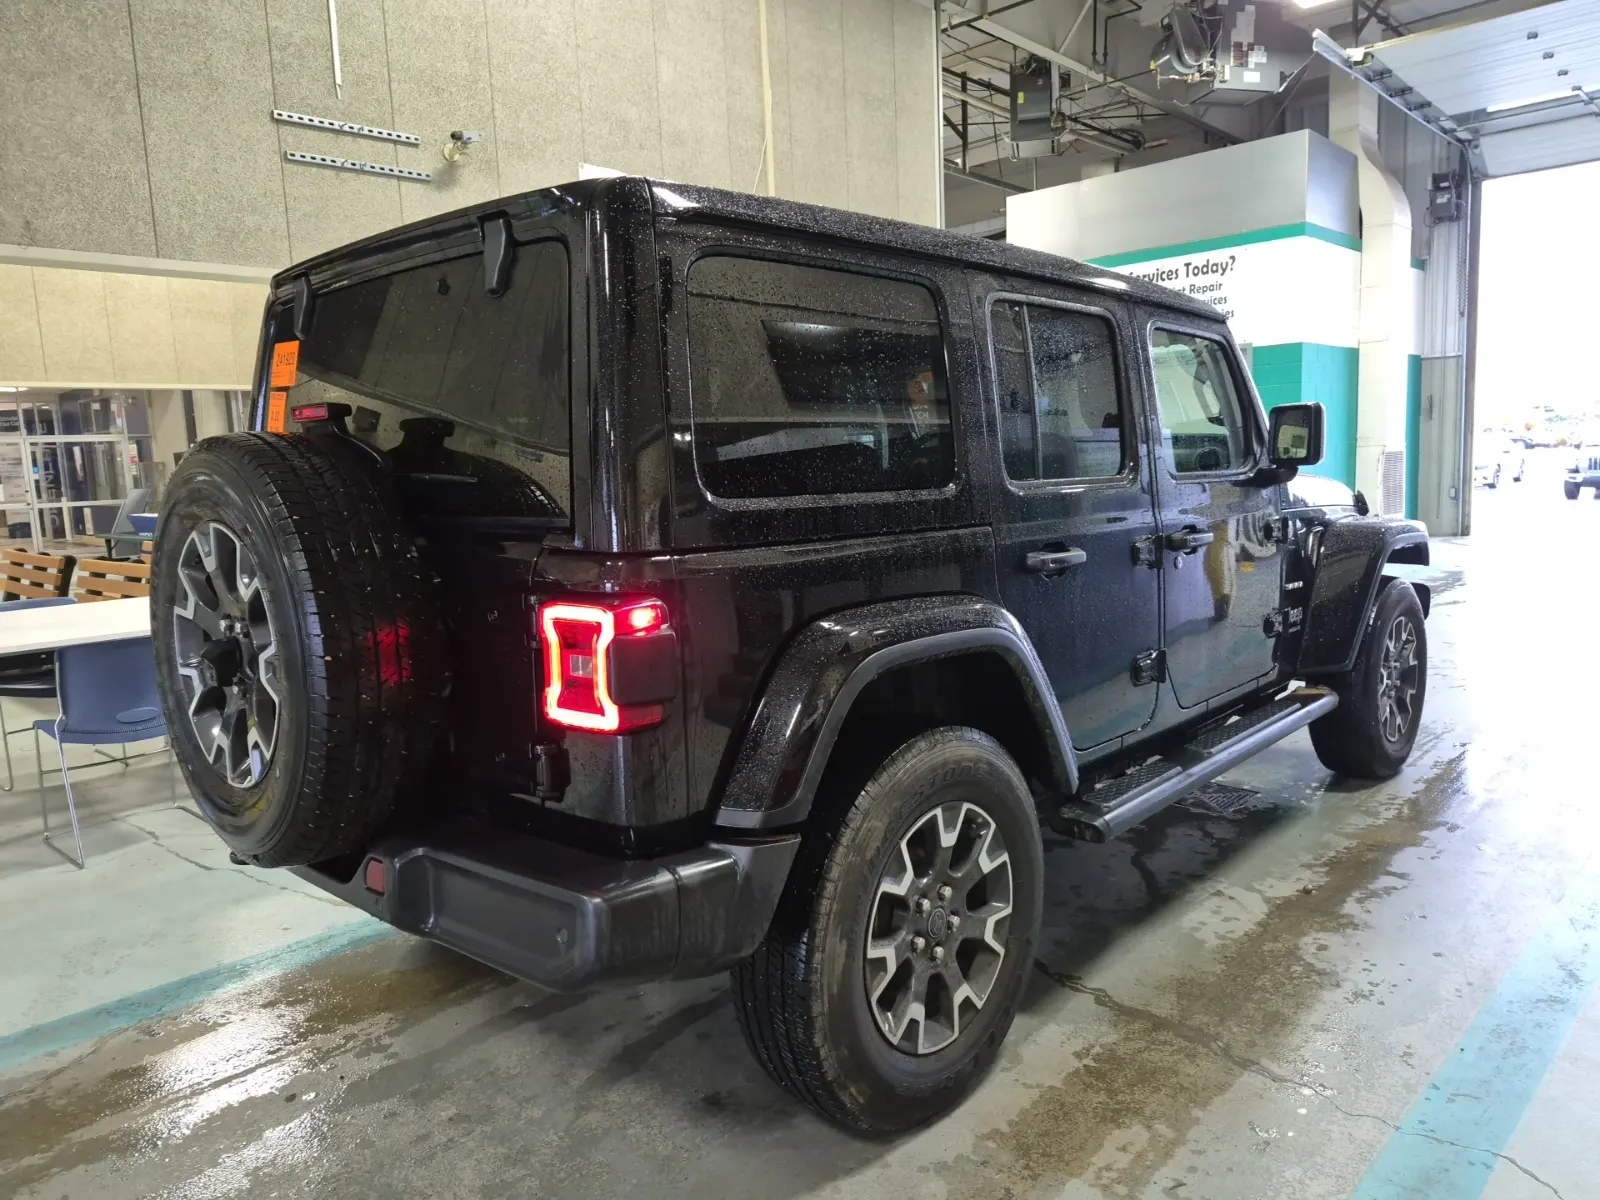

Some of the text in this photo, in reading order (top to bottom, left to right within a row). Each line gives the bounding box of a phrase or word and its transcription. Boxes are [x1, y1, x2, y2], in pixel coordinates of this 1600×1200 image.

[1129, 255, 1236, 283] rvices Today?
[1189, 281, 1223, 295] Repair
